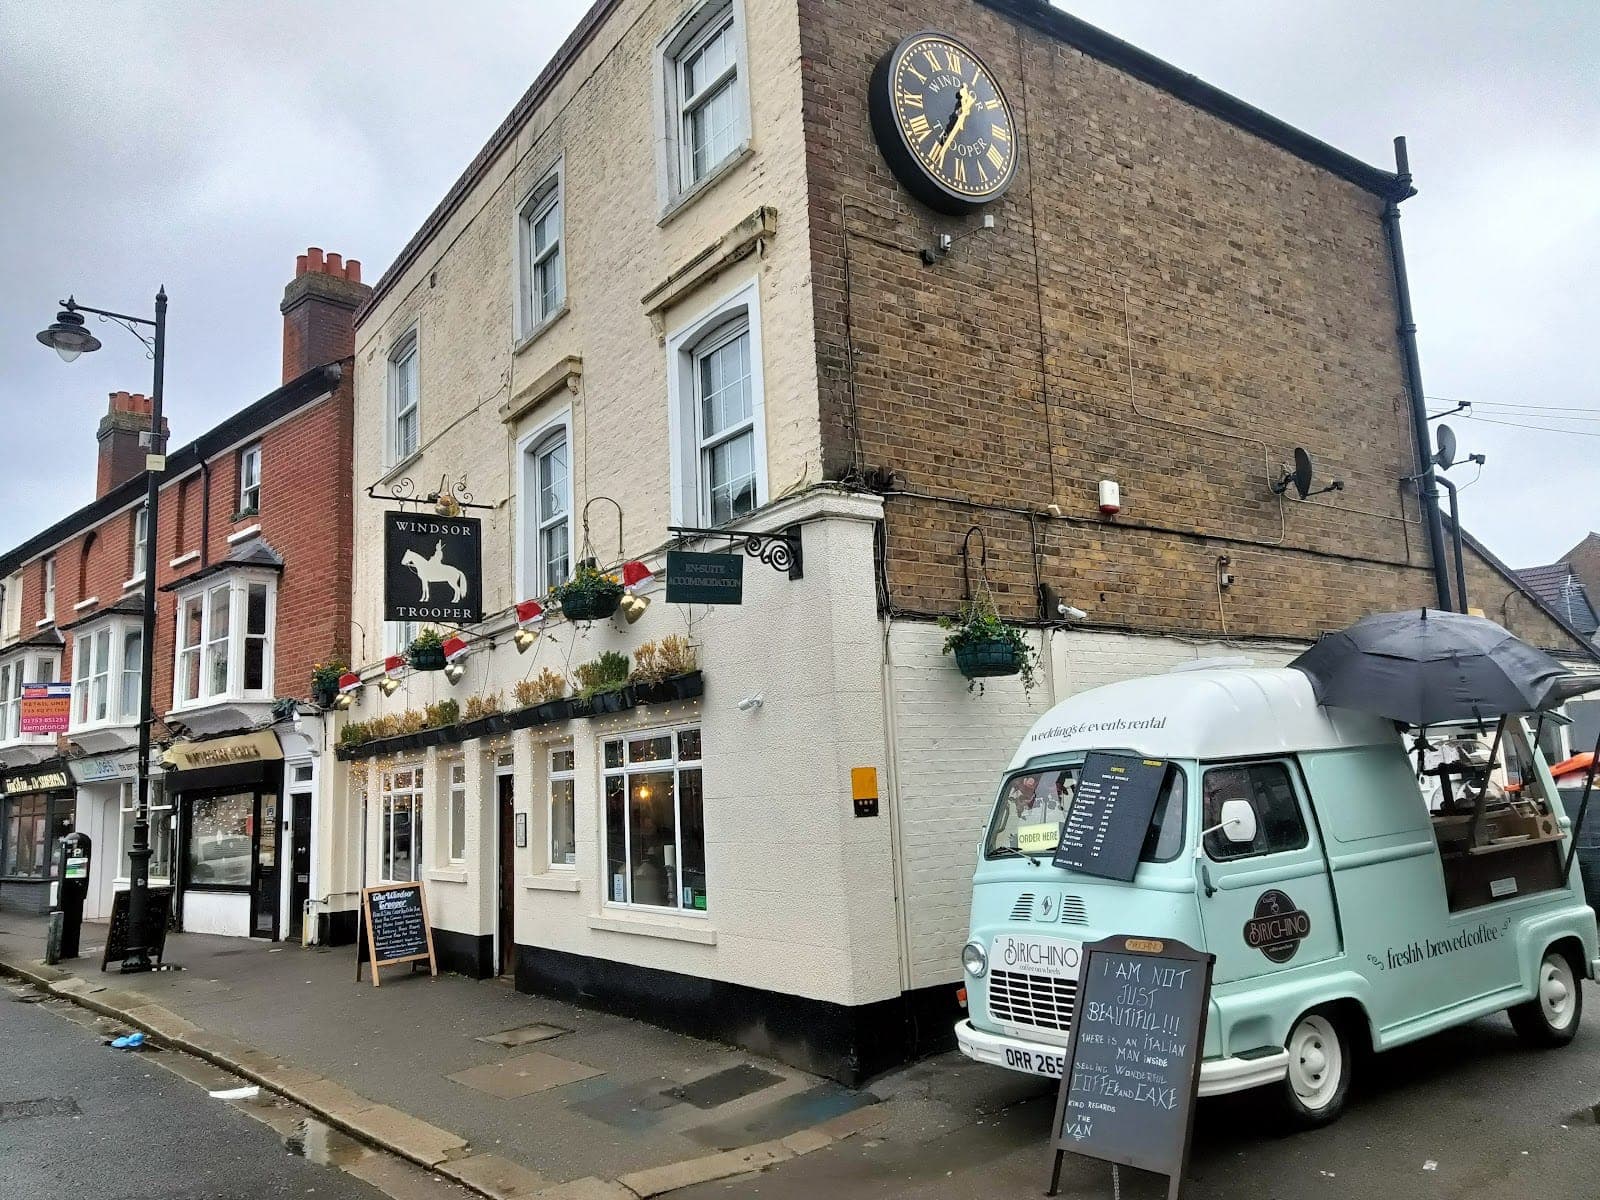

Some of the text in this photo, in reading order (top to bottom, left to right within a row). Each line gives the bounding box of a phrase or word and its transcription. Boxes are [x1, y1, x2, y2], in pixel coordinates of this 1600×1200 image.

[396, 521, 472, 536] WINDSOR
[668, 576, 740, 588] ACCOMMODATION
[396, 606, 472, 619] TROOPER
[1031, 716, 1167, 742] weddings & events rental
[1019, 832, 1039, 844] ORDER
[1041, 831, 1058, 842] HERE
[1250, 915, 1308, 944] BIRICHINO
[1426, 929, 1467, 959] brewed
[1467, 923, 1498, 947] coffee
[1004, 938, 1079, 968] BIRICHINO
[1152, 965, 1192, 990] NOT
[1117, 983, 1159, 1010] JUST
[1081, 1032, 1105, 1045] THERE
[1124, 1038, 1138, 1048] AN
[1006, 1048, 1033, 1070] ORR
[1116, 1046, 1140, 1063] MAN
[1071, 1072, 1178, 1111] COFFEE AND CAKE
[1067, 1099, 1117, 1113] KIND REGARDS
[1077, 1114, 1092, 1123] THE
[1066, 1122, 1093, 1137] VAN
